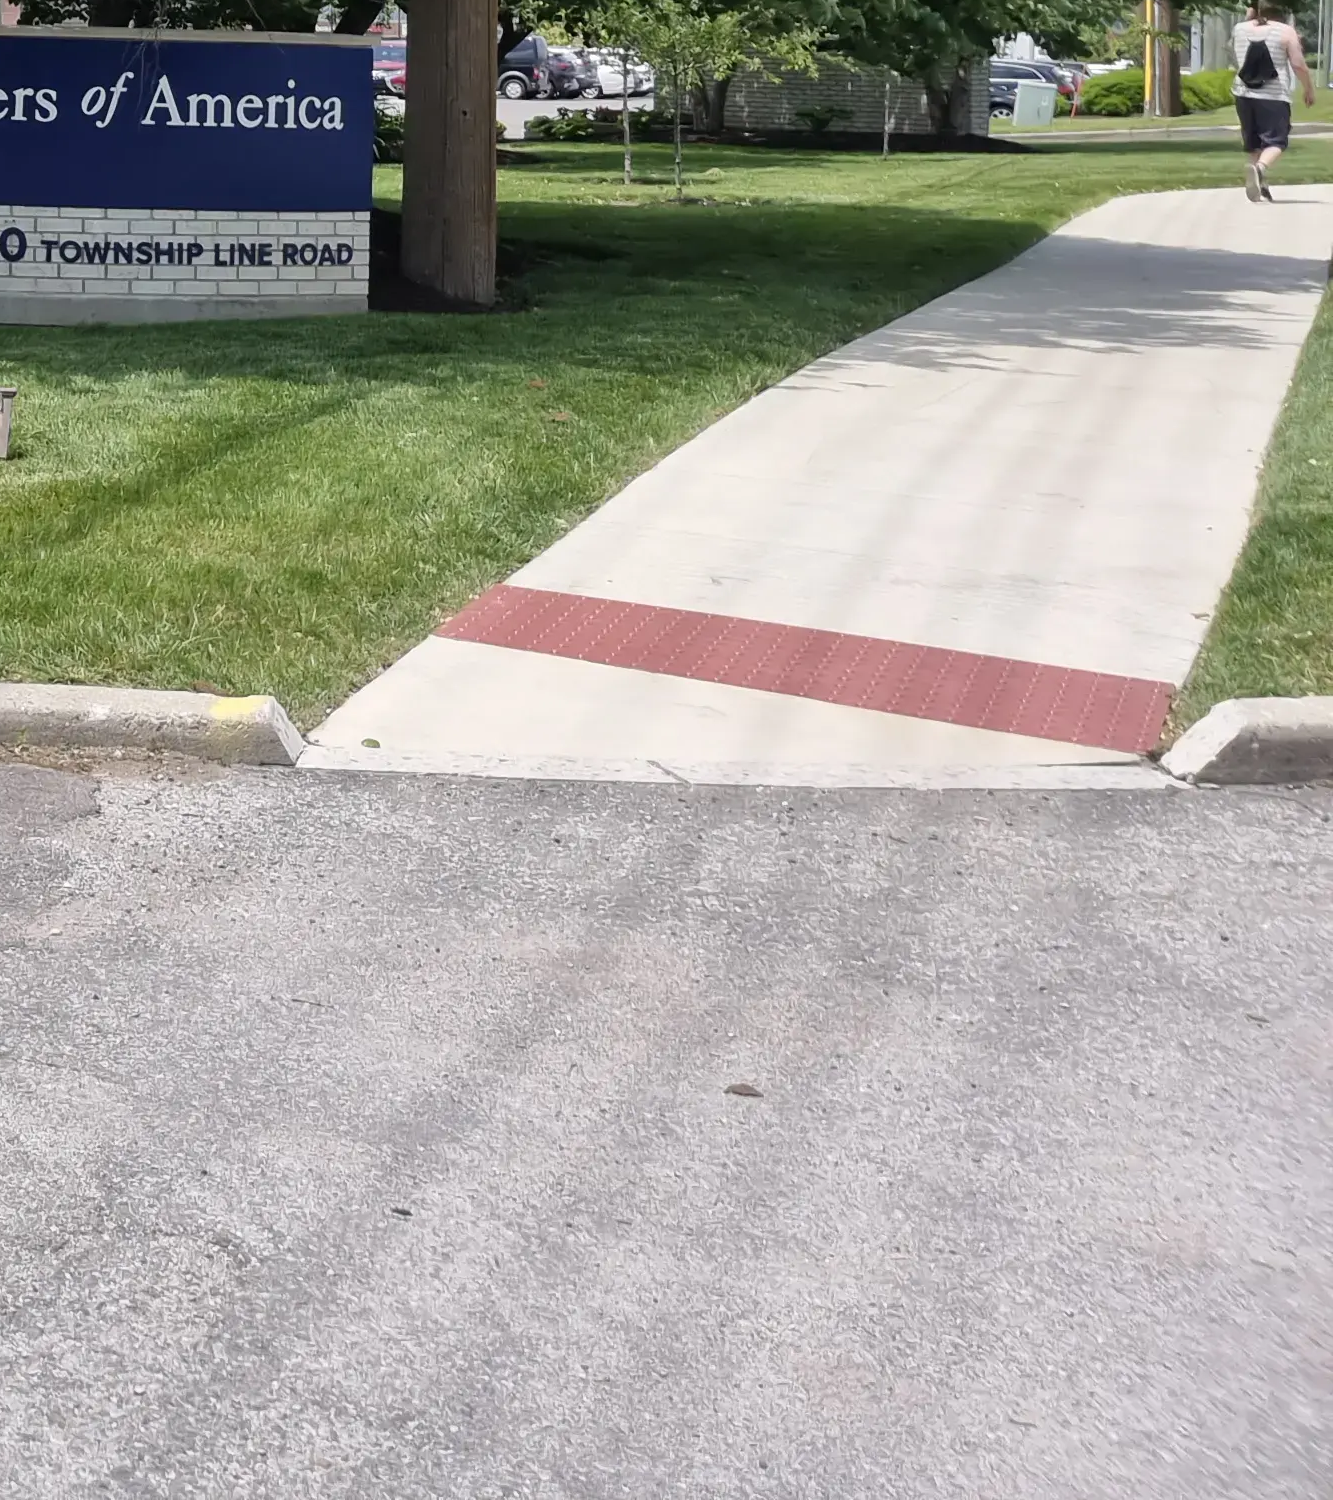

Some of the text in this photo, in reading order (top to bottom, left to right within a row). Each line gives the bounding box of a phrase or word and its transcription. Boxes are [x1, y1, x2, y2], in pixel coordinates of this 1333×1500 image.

[81, 71, 135, 129] of
[140, 74, 345, 130] America
[40, 239, 205, 266] TOWNSHIP
[213, 243, 274, 267] LINE
[281, 243, 354, 267] ROAD
